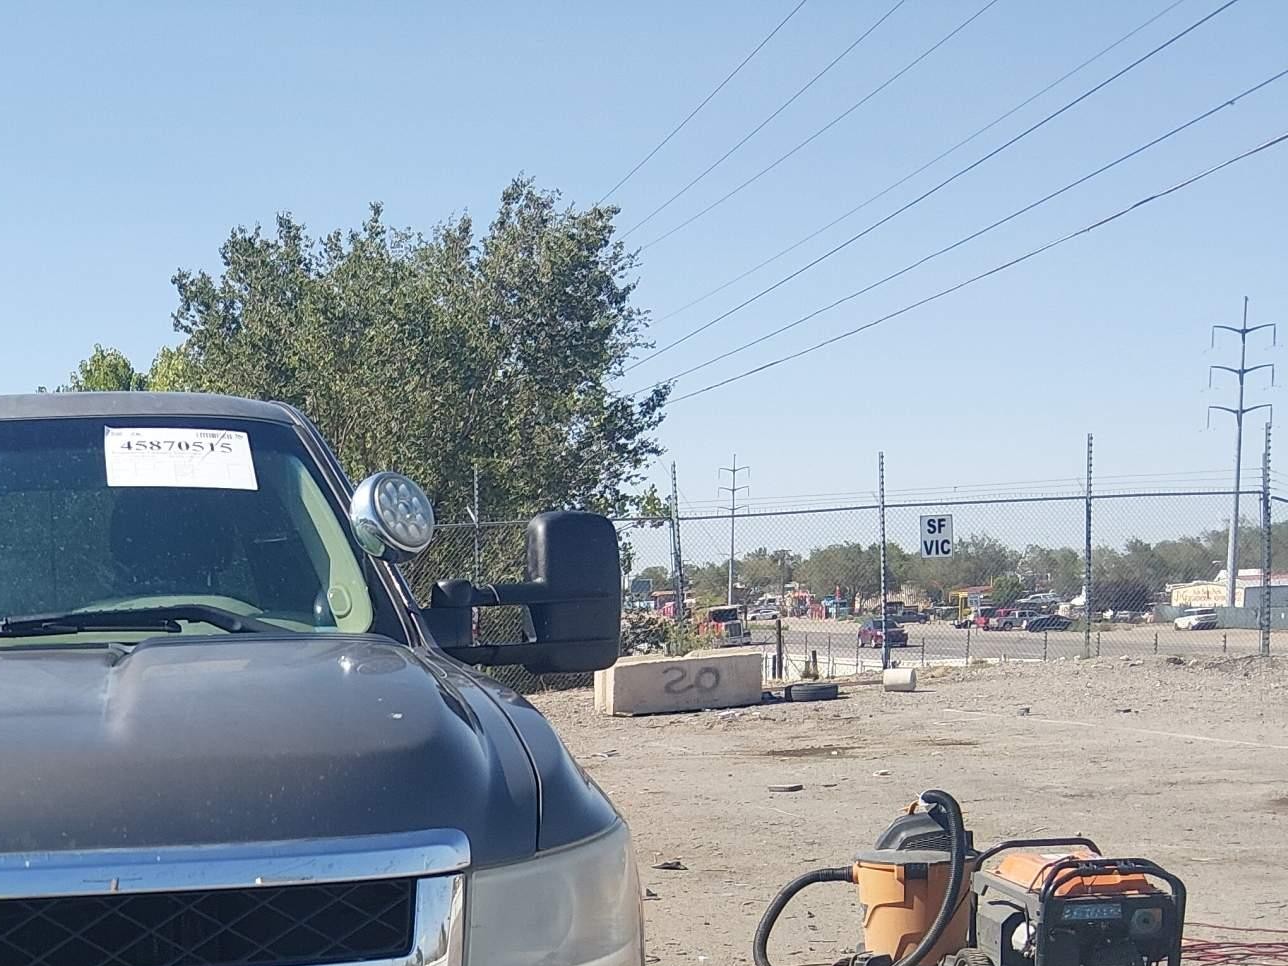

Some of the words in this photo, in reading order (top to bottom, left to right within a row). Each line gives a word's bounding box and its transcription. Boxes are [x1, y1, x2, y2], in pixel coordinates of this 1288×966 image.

[120, 440, 233, 453] 45870515
[926, 518, 946, 535] SF
[923, 539, 951, 556] VIC
[661, 666, 721, 694] 20
